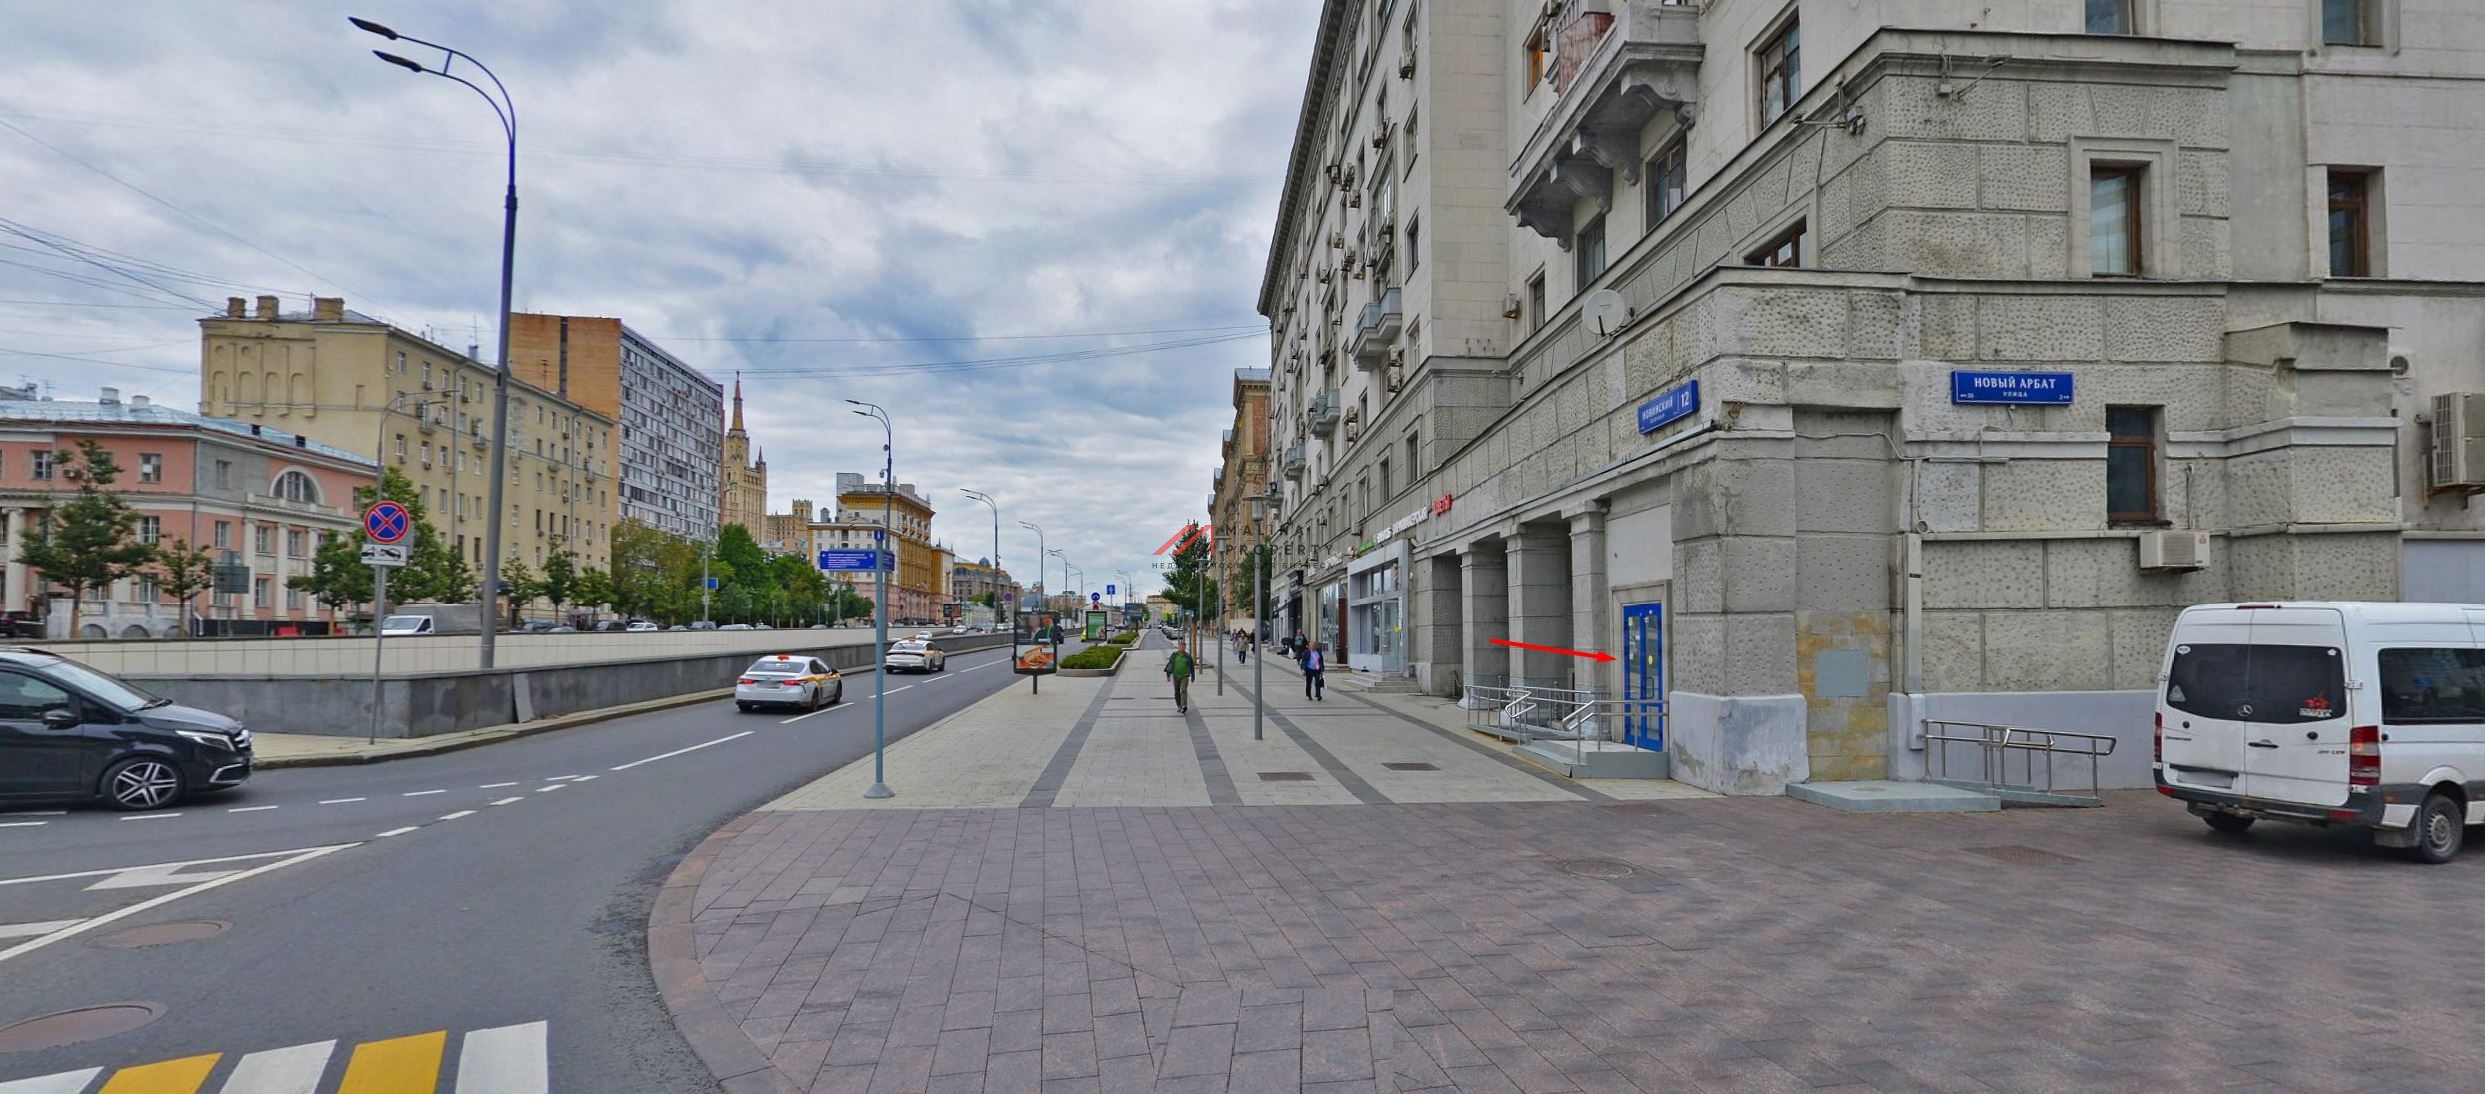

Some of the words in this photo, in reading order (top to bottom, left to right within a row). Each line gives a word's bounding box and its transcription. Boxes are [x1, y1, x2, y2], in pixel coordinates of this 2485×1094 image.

[1974, 376, 2016, 388] НОВЫЙ
[2019, 378, 2056, 389] АРБАТ
[1681, 391, 1690, 408] 12
